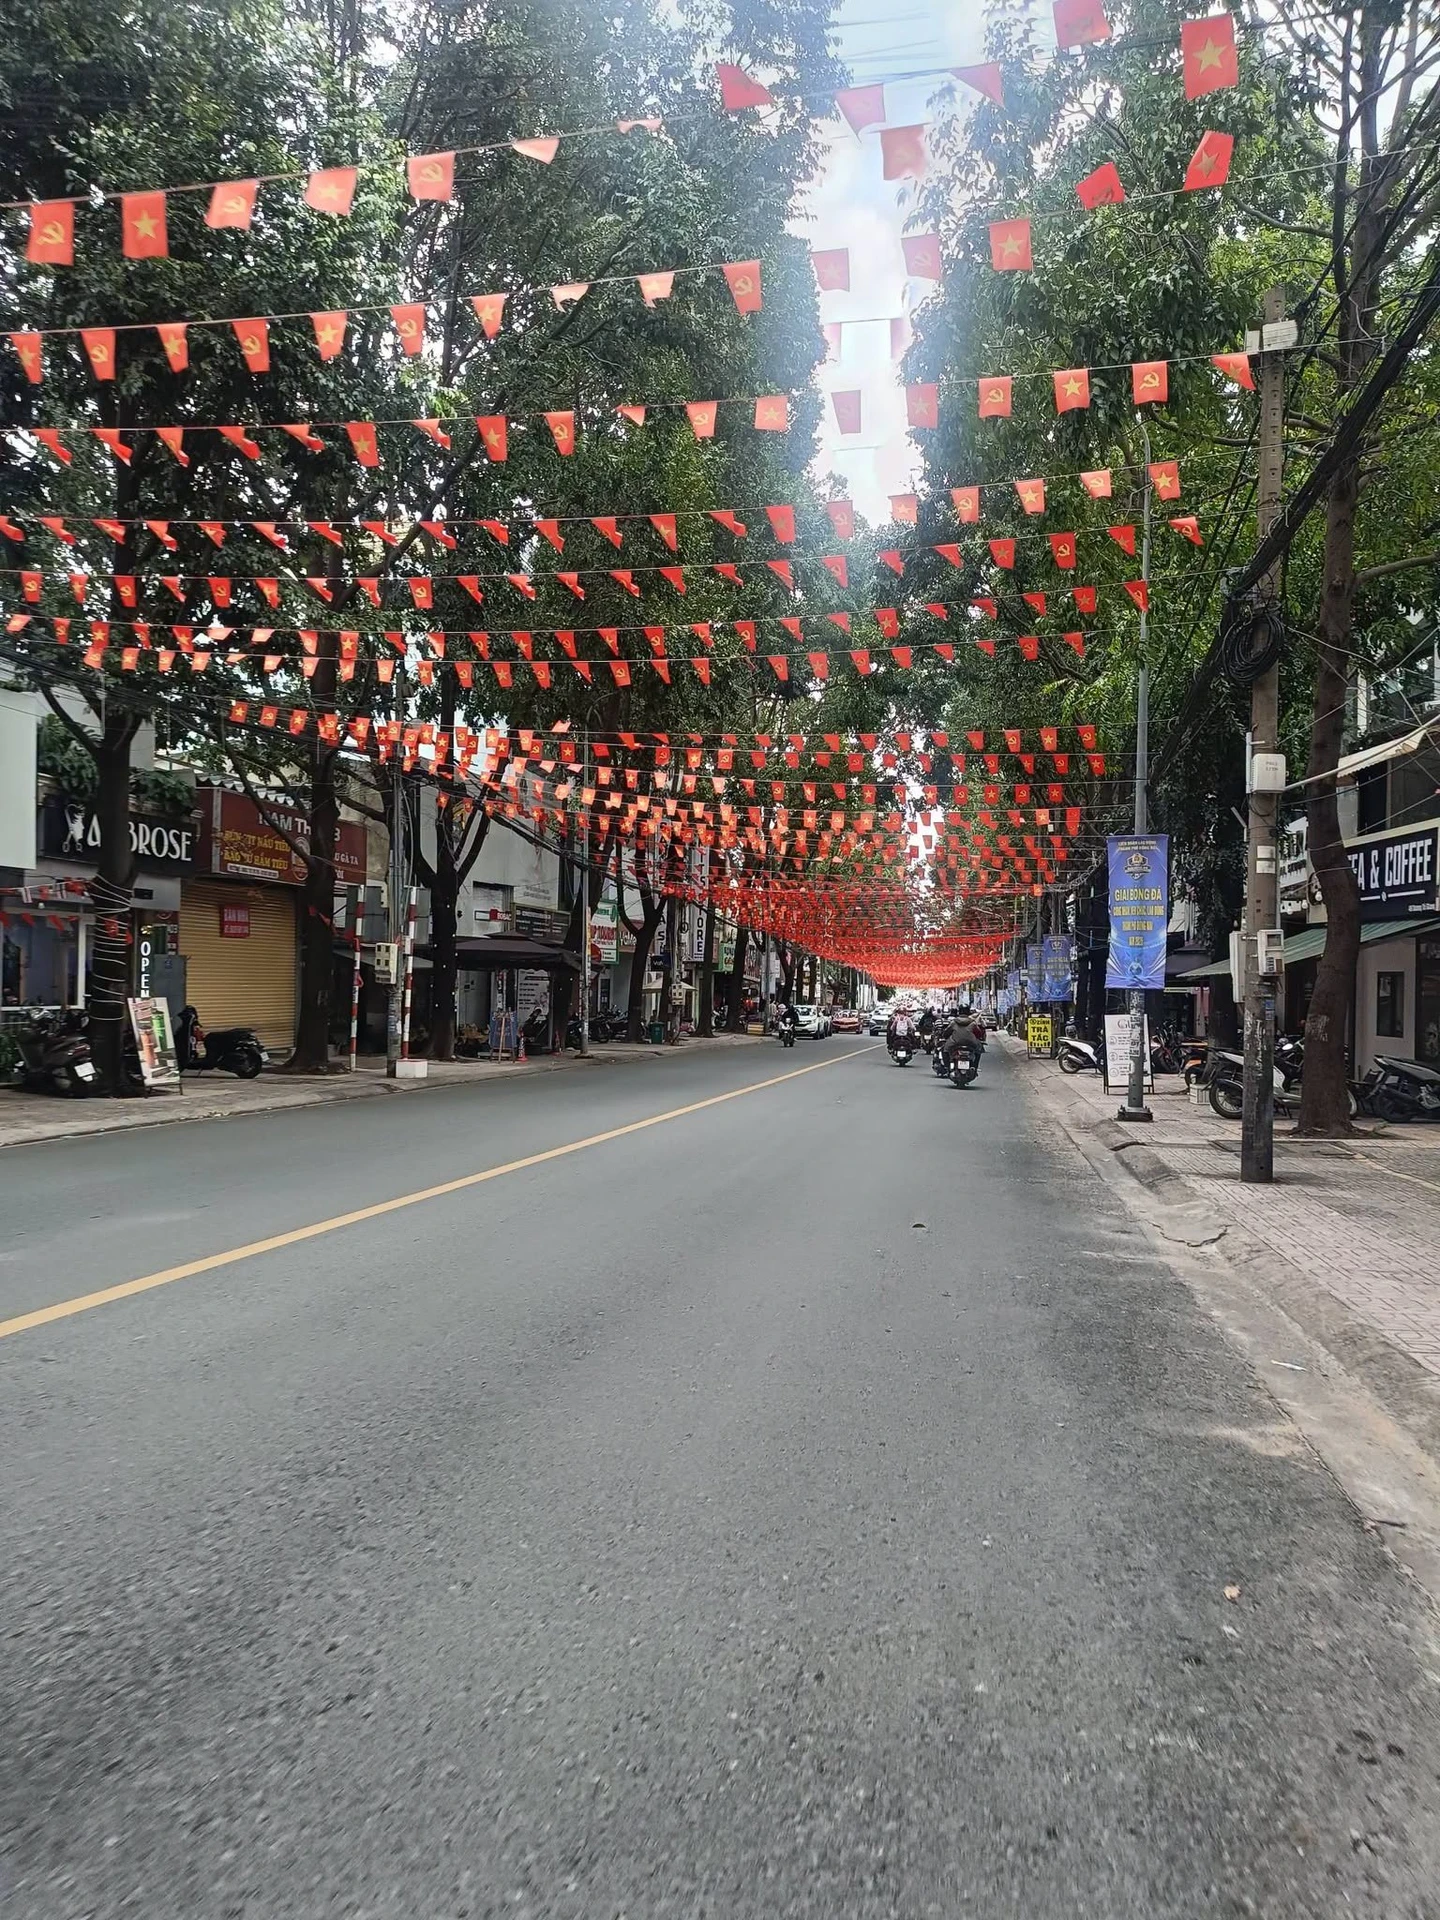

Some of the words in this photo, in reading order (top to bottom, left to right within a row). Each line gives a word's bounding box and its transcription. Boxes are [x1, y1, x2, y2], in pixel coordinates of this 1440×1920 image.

[86, 813, 193, 862] ABROSE
[1370, 850, 1379, 889] &
[1385, 838, 1433, 887] COFFEE
